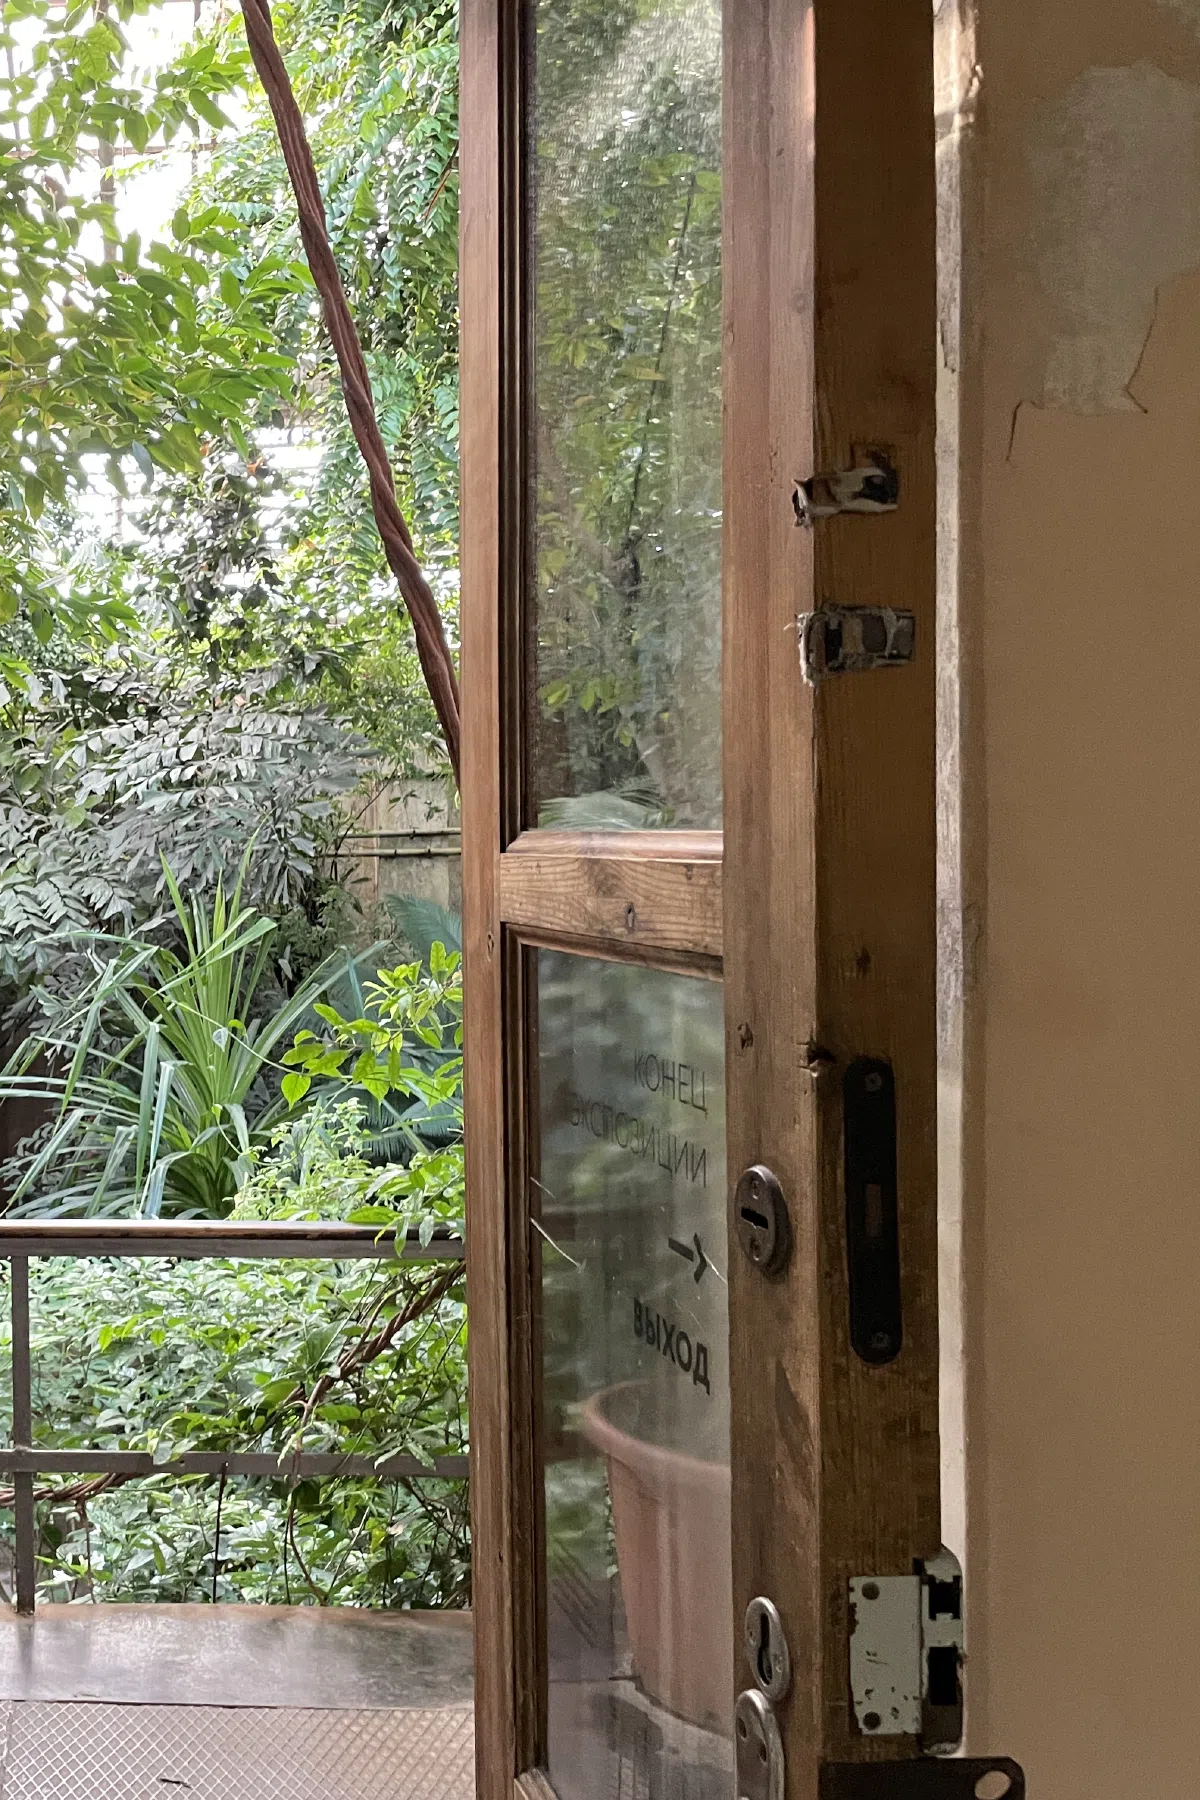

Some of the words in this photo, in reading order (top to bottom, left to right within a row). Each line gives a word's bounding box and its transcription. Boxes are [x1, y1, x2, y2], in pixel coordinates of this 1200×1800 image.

[633, 1048, 708, 1121] КОНЕЦ
[570, 1091, 707, 1189] ЭКСПОЗИЦИИ
[633, 1295, 712, 1396] ВЫХОД
